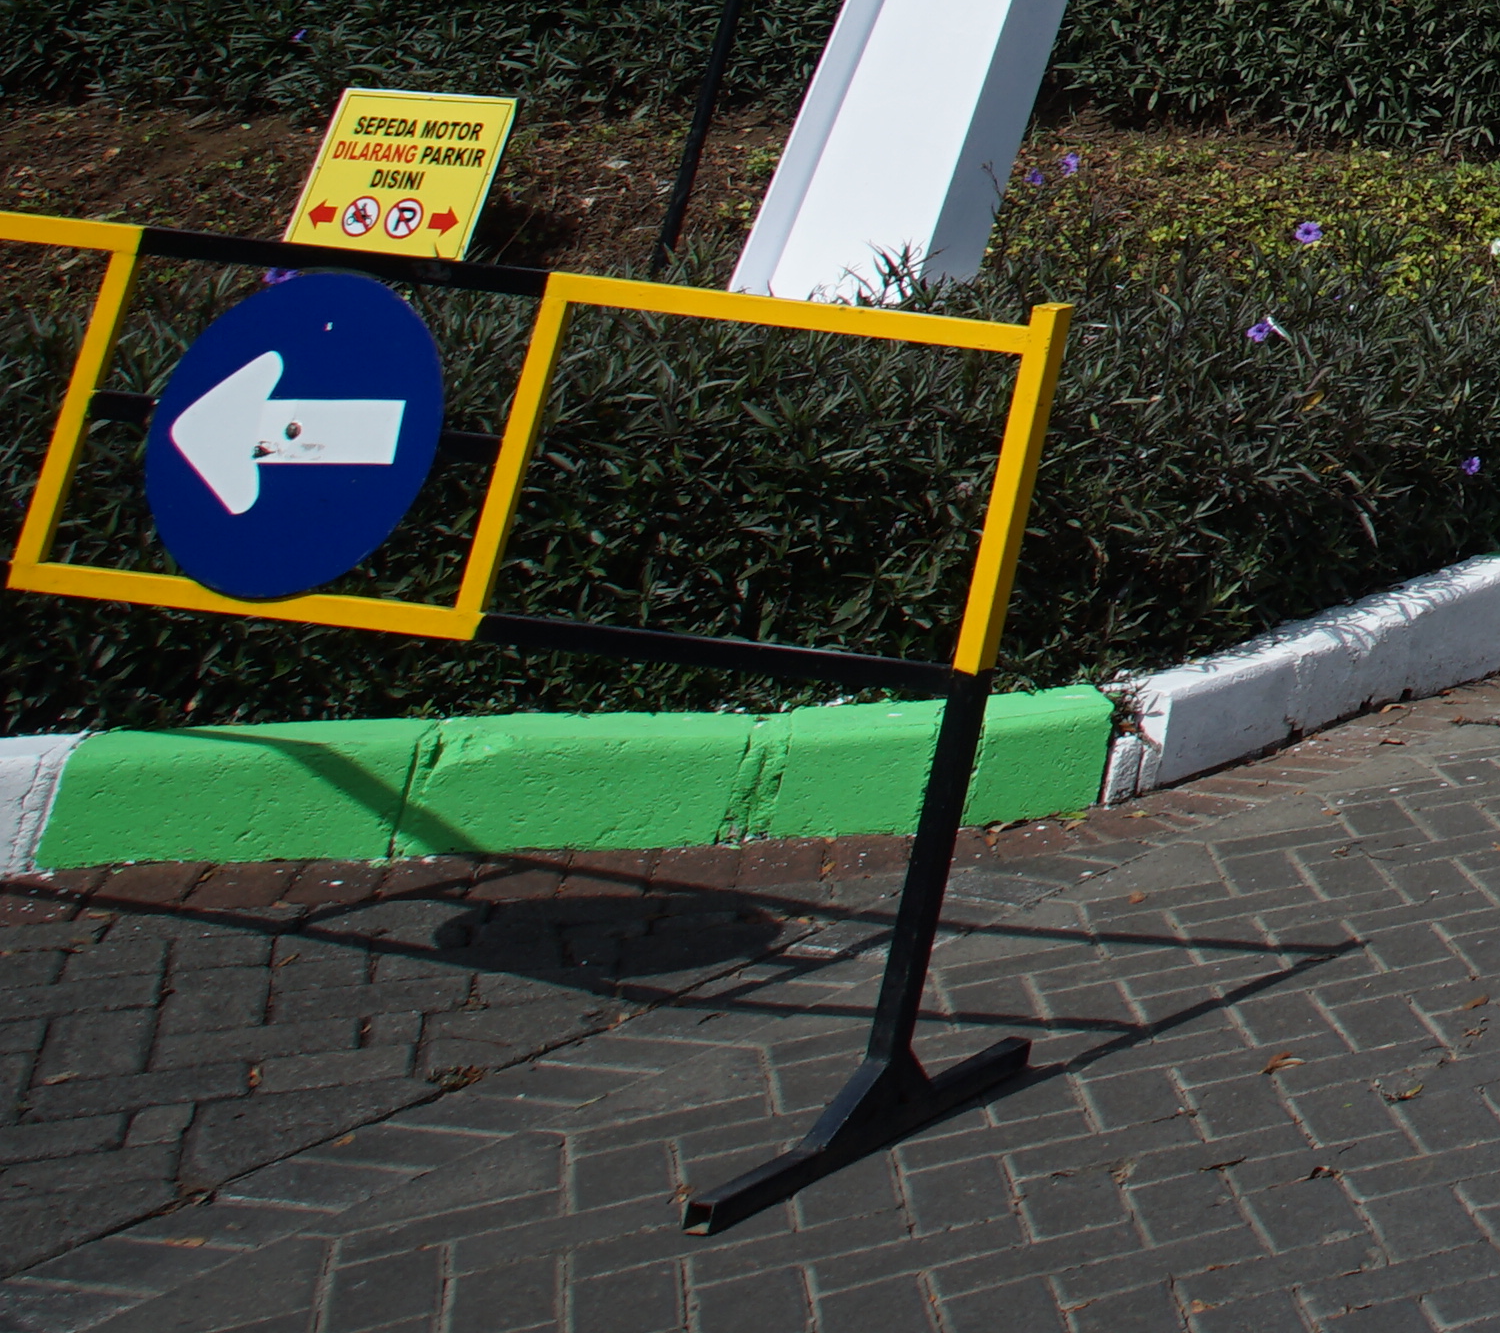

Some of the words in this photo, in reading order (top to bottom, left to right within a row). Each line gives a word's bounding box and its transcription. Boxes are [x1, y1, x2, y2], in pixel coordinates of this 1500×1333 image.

[354, 116, 418, 137] SEPEDA
[420, 120, 484, 141] MOTOR
[332, 141, 418, 164] DILARANG
[419, 146, 487, 168] PARKIR
[370, 169, 426, 190] DISINI
